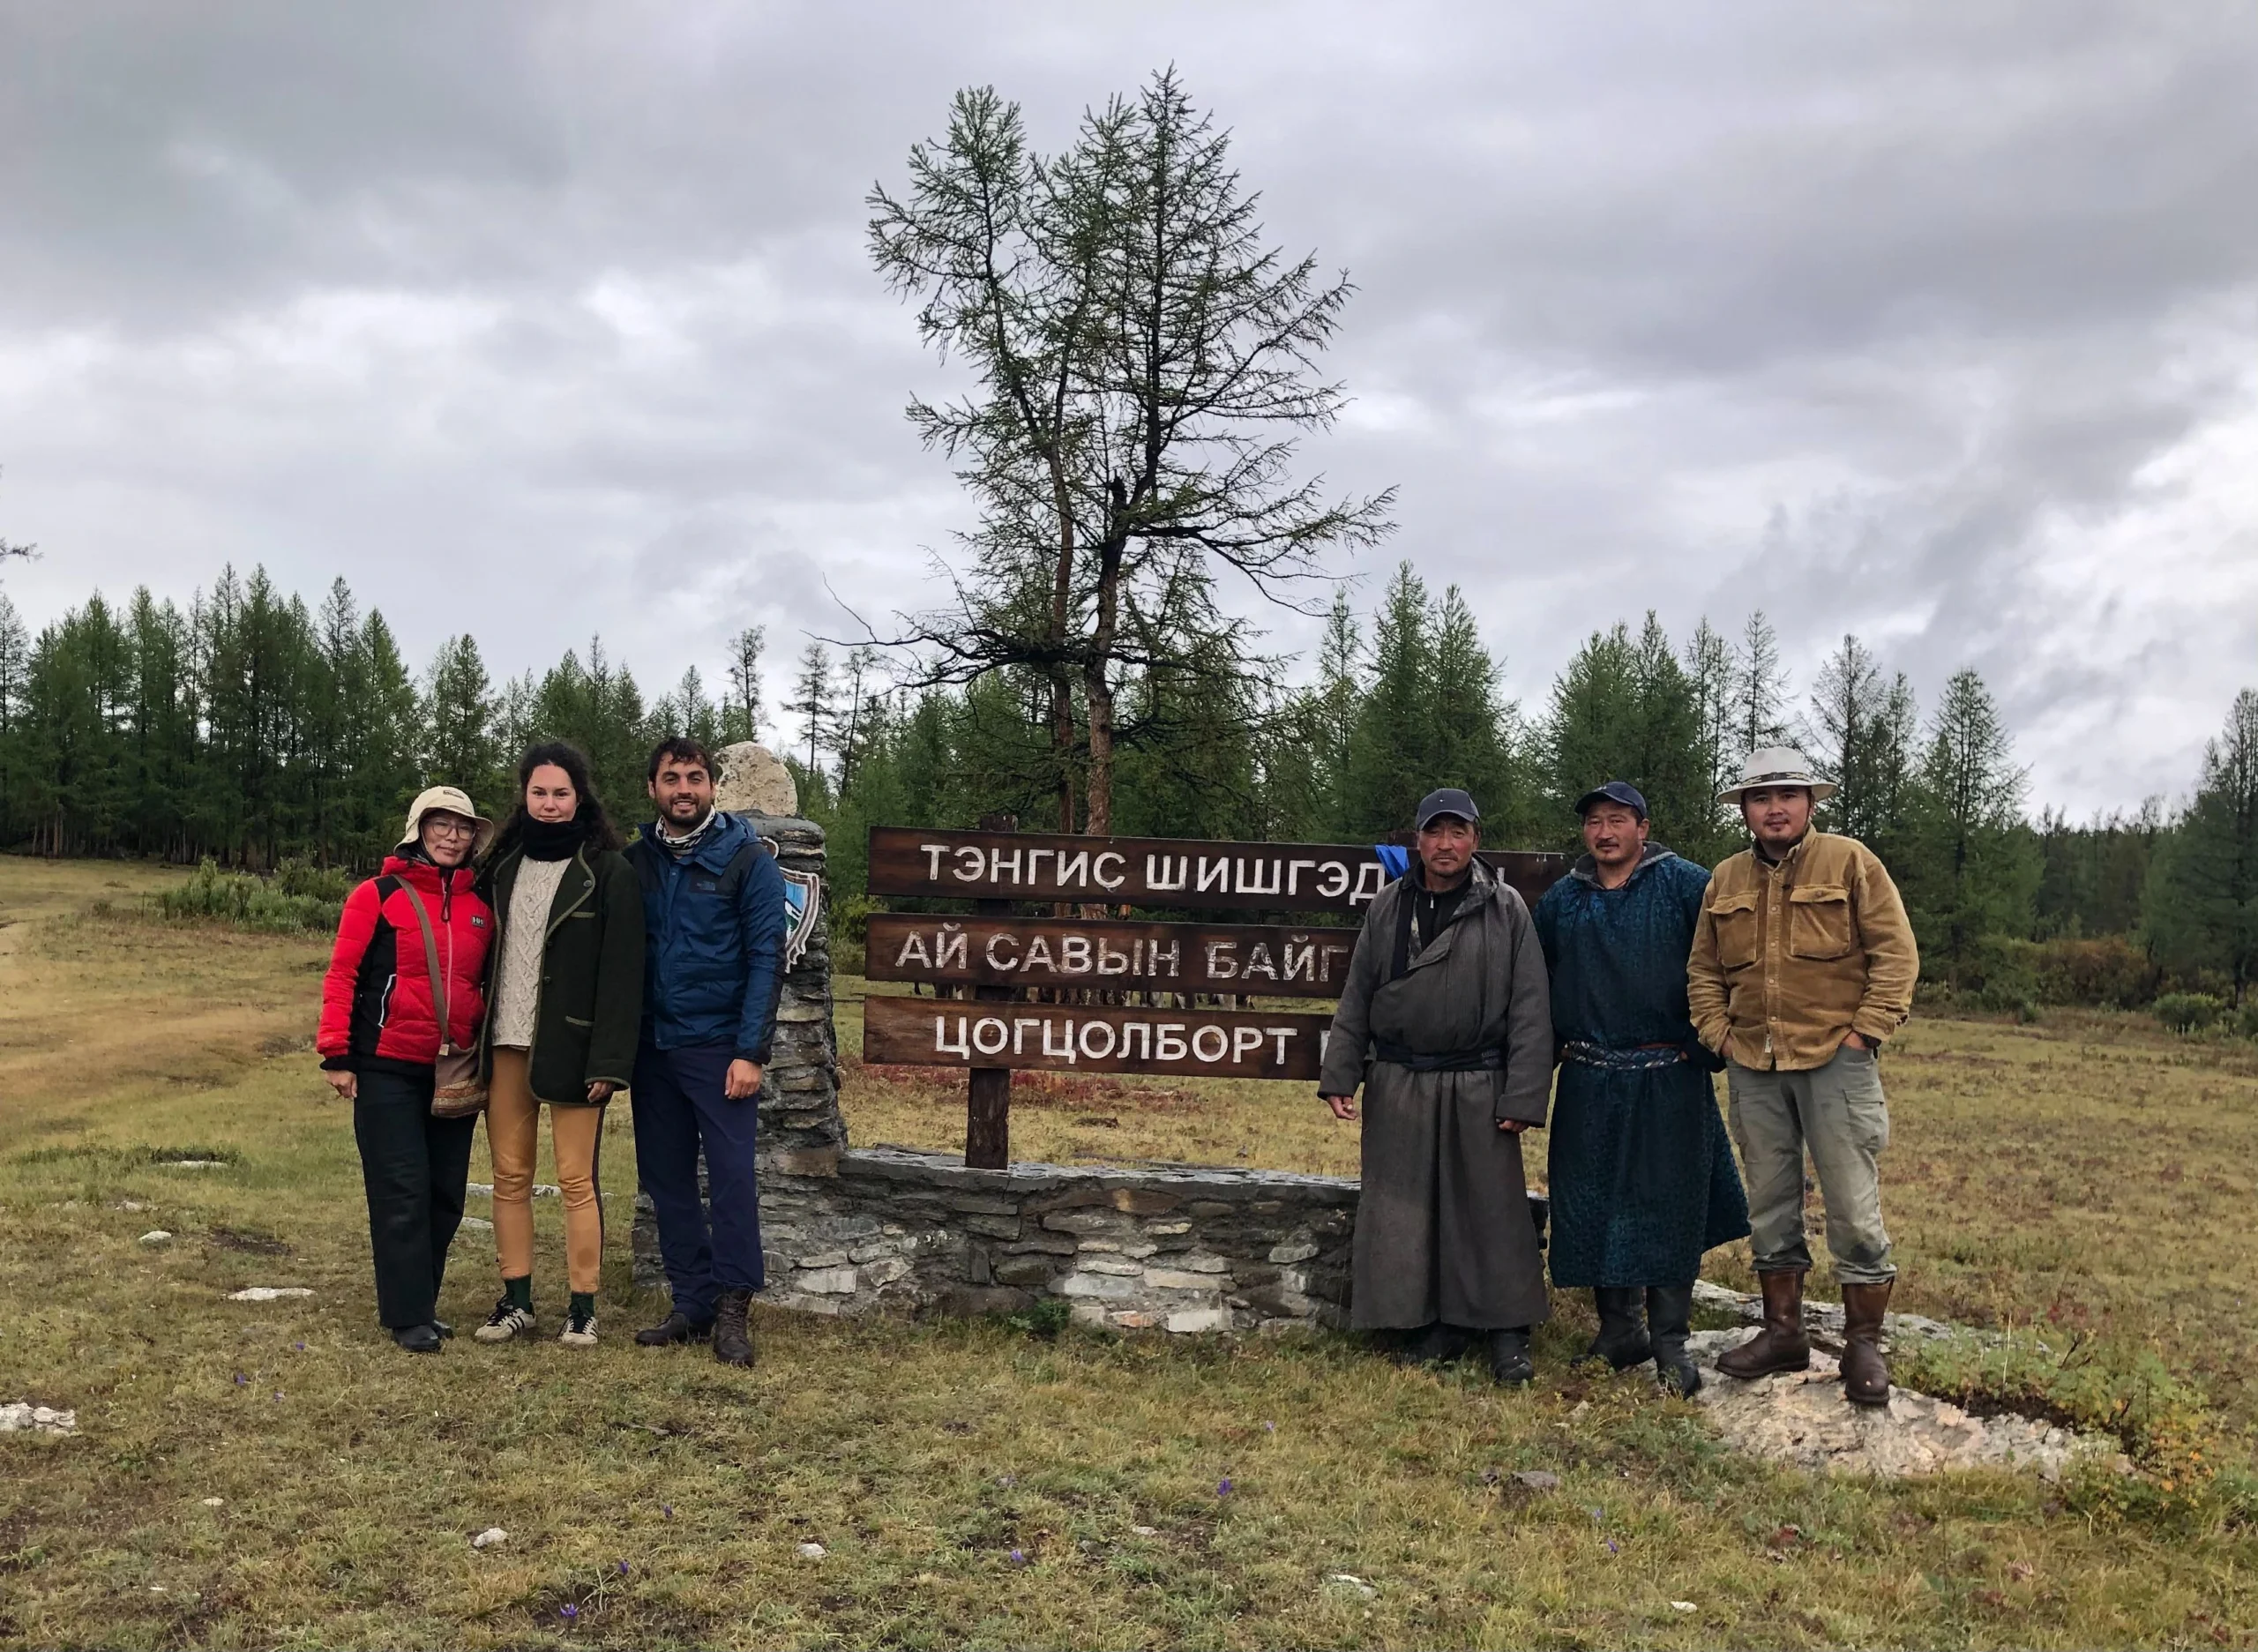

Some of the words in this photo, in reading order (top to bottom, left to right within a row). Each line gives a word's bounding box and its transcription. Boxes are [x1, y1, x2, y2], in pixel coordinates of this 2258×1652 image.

[920, 844, 1126, 888] ТЭНГИС
[1146, 852, 1505, 905] ШИШГЭД
[894, 922, 968, 969] АЙ
[985, 932, 1179, 977] САВЫН
[936, 1015, 1297, 1065] ЦОГЦОЛБОРТ
